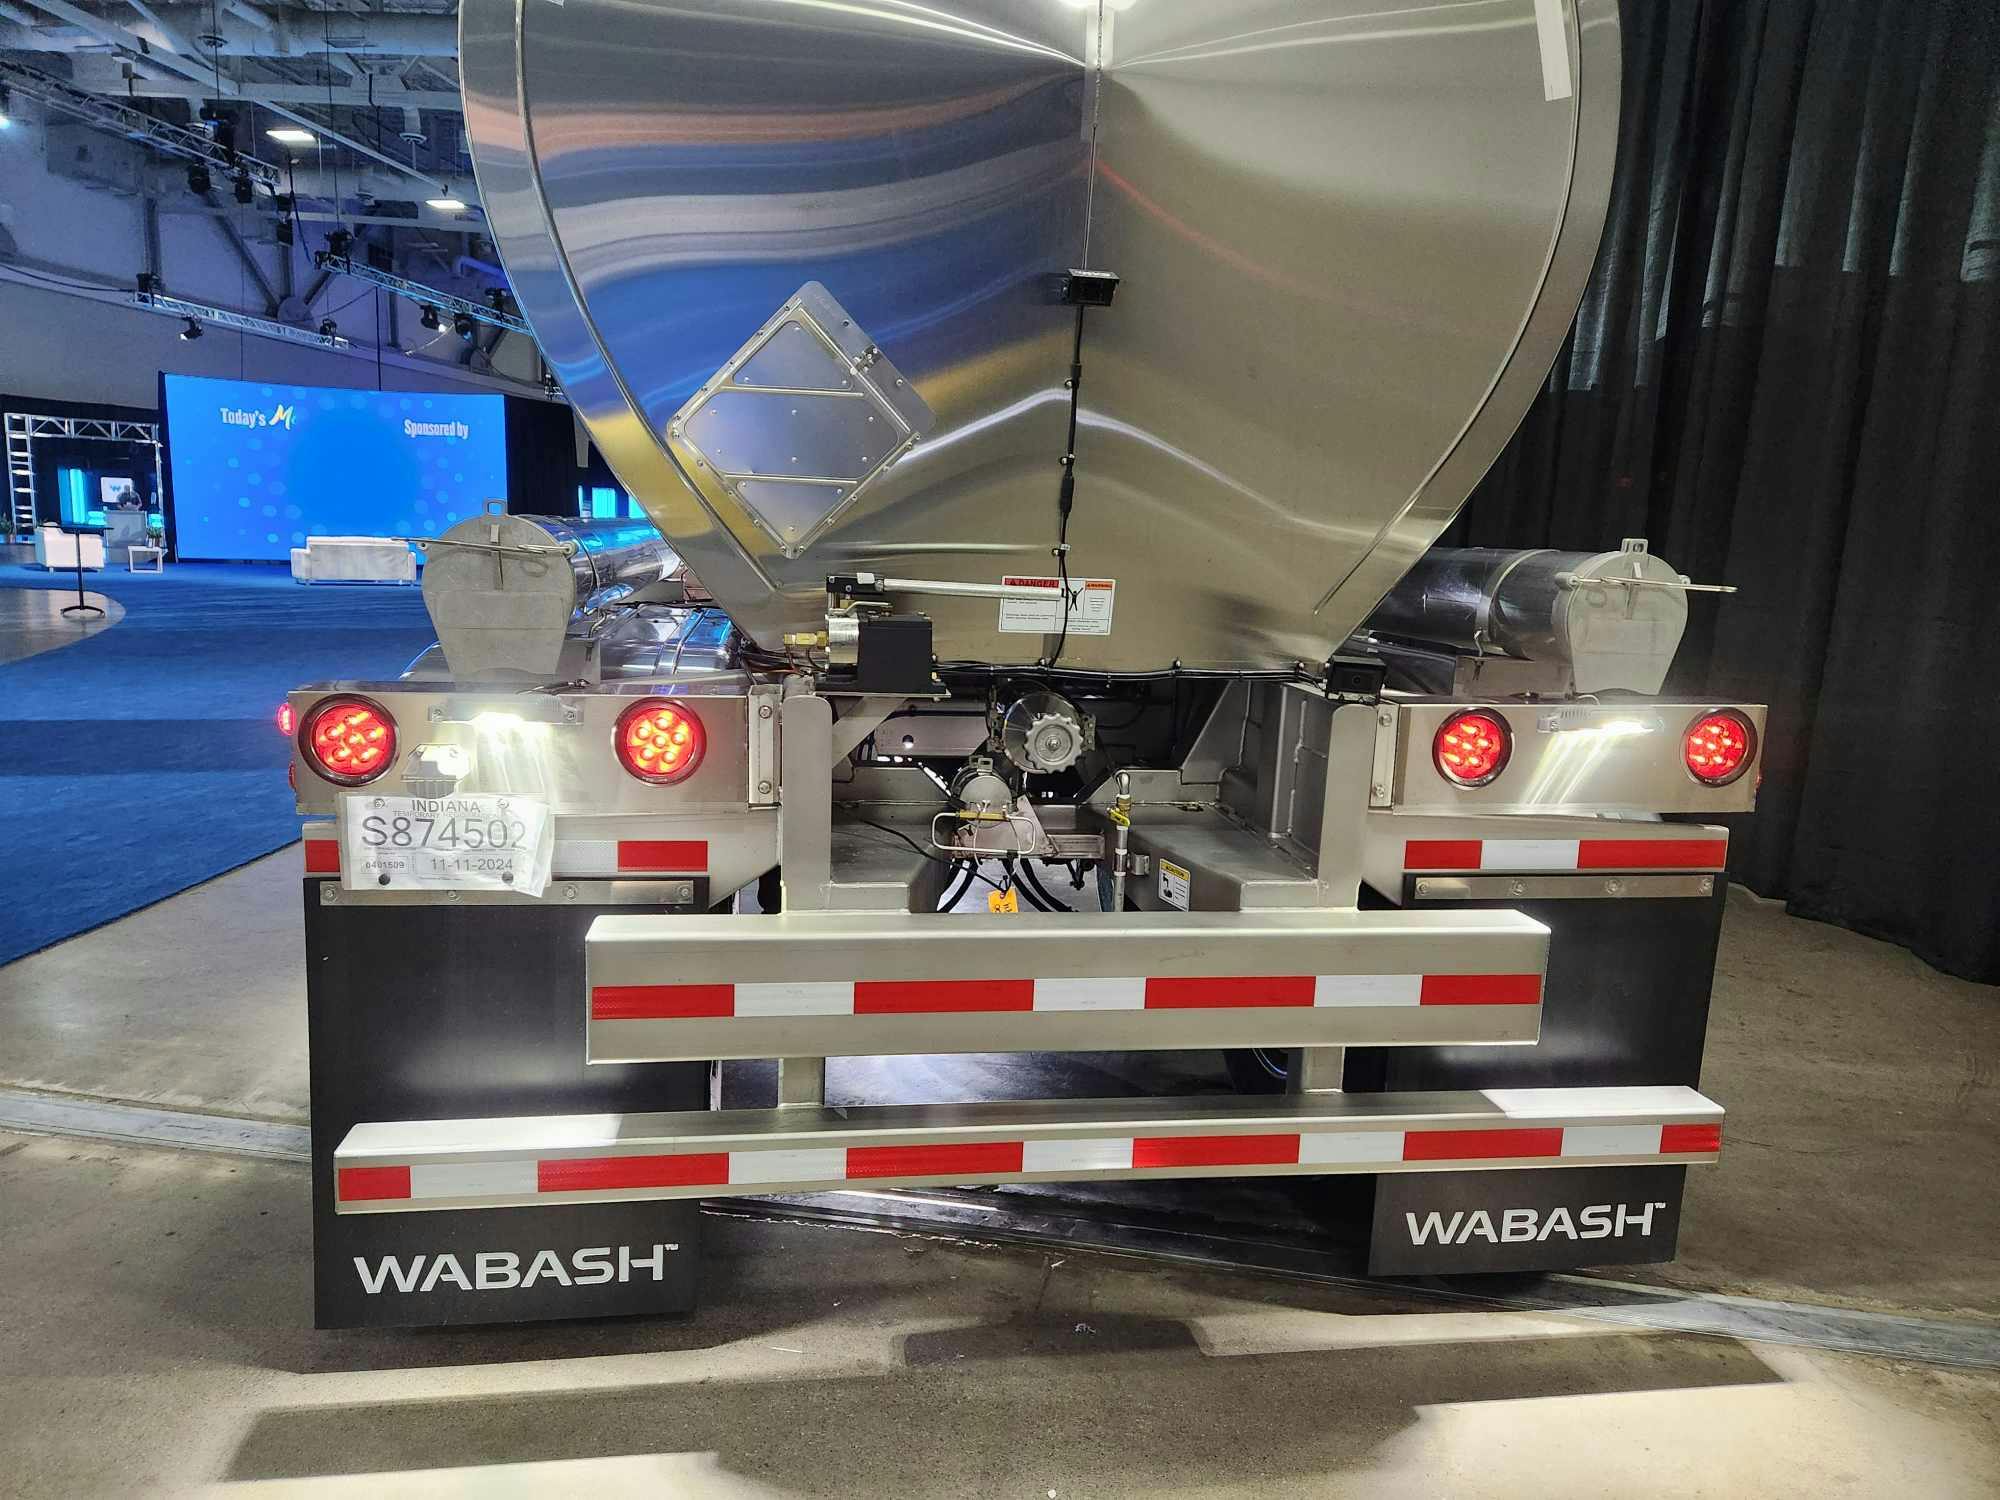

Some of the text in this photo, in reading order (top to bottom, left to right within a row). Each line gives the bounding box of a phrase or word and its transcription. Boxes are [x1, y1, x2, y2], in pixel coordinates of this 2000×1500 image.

[220, 408, 266, 429] Today's
[404, 419, 469, 440] Sponsored by
[412, 800, 481, 813] INDIANA
[361, 815, 527, 850] S874502
[431, 859, 513, 871] 11-11-2024
